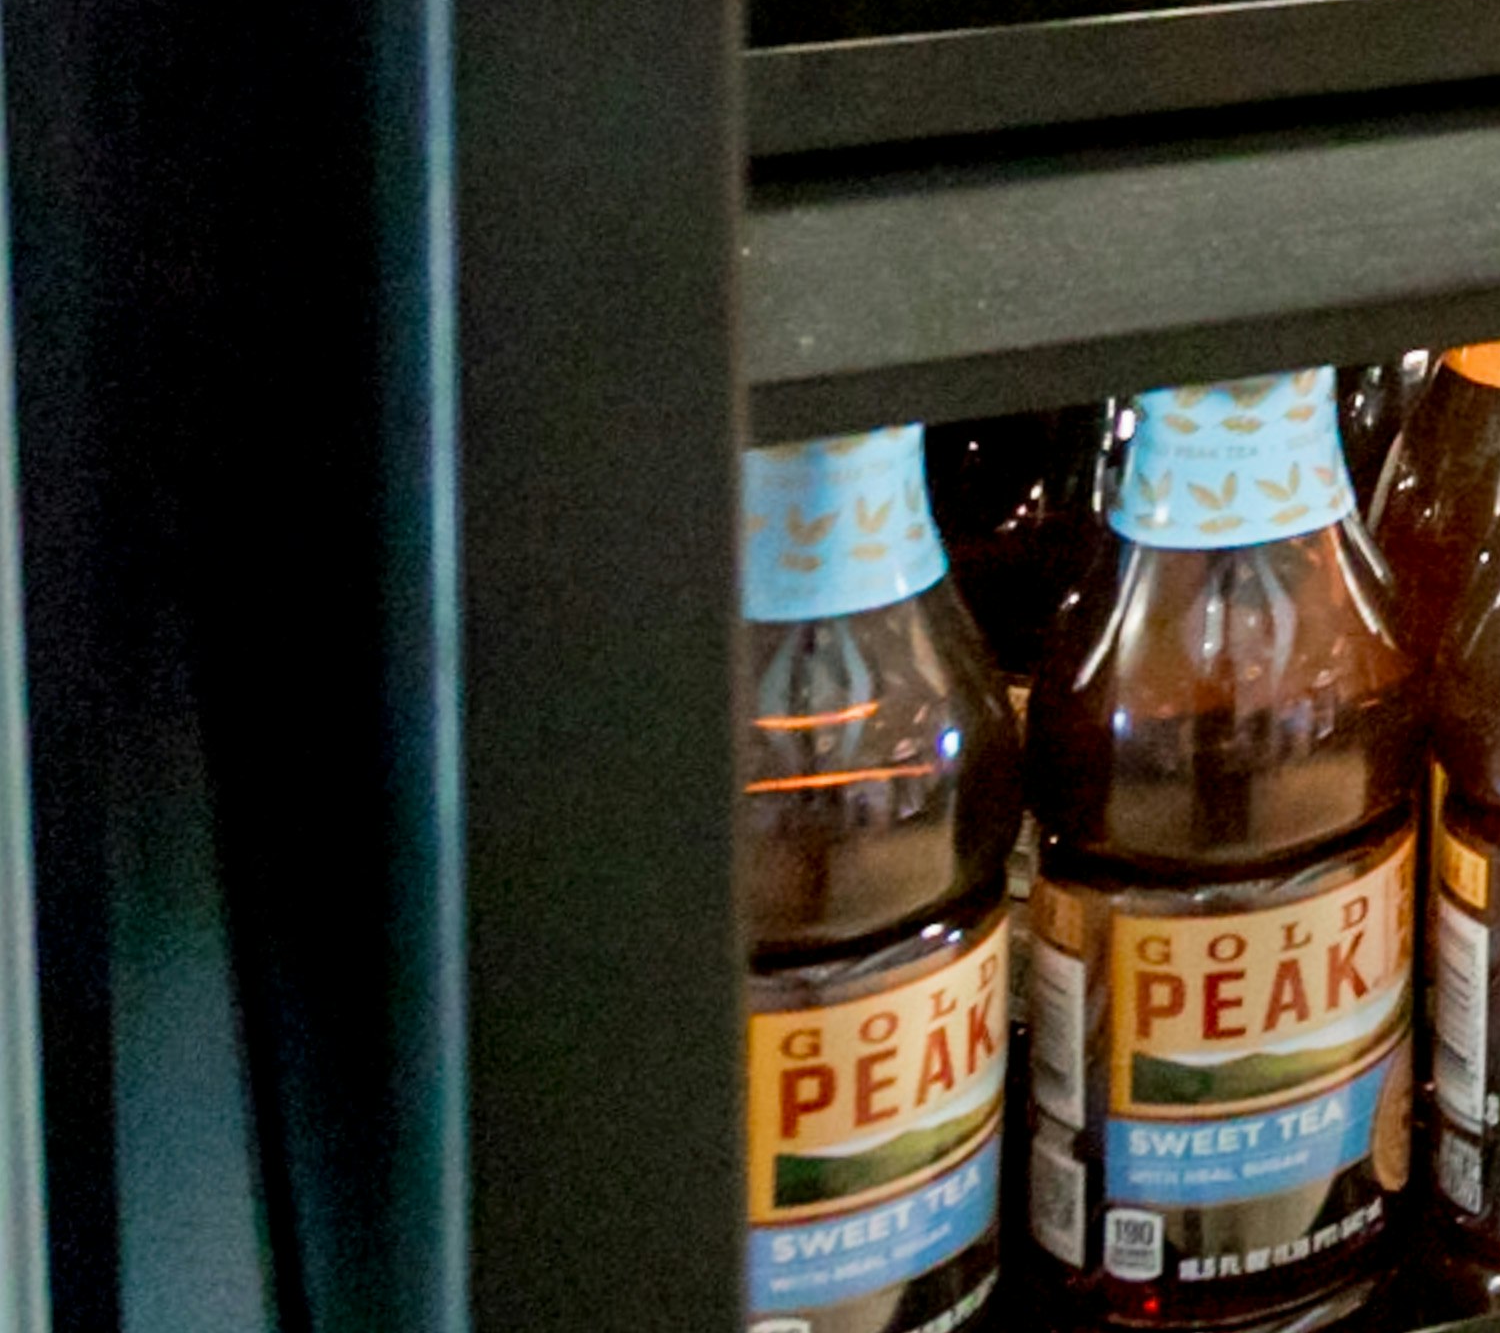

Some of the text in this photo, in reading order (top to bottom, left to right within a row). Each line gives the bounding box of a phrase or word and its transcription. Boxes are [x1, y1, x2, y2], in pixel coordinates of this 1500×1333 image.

[1135, 895, 1369, 965] GOLD
[780, 955, 998, 1059] GOLD
[1133, 930, 1370, 1041] PEAK
[780, 993, 998, 1139] PEAK
[1127, 1099, 1345, 1159] SWEET TEA
[771, 1199, 917, 1265] SWEET
[923, 1164, 982, 1209] TEA
